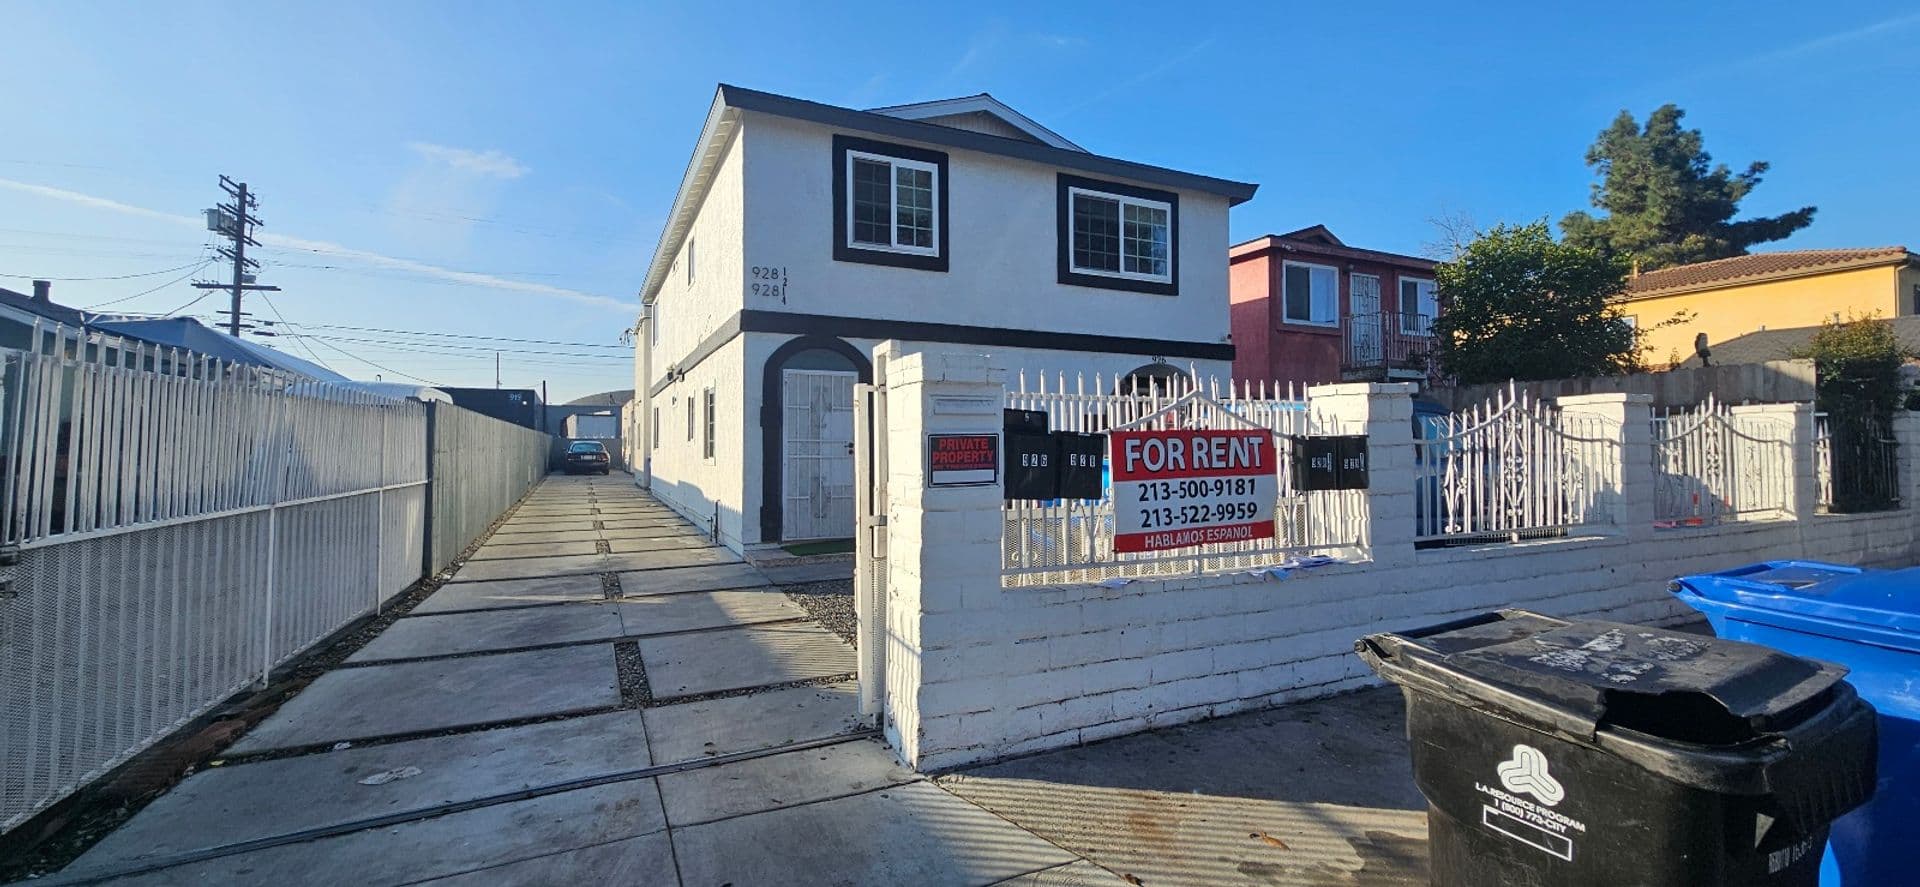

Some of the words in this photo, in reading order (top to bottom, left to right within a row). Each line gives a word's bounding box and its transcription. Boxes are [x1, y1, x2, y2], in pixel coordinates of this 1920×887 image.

[752, 266, 779, 280] 928
[752, 283, 779, 297] 928
[932, 449, 994, 463] PROPERTY
[938, 438, 989, 451] PRIVATE
[1125, 437, 1186, 472] FOR
[1191, 436, 1263, 470] RENT
[1138, 479, 1256, 502] 213-500-9181
[1140, 502, 1258, 528] 213-522-9959
[1144, 529, 1204, 549] HABLAMOS
[1207, 525, 1253, 541] ESPANOL
[1536, 806, 1586, 833] PROGRAM
